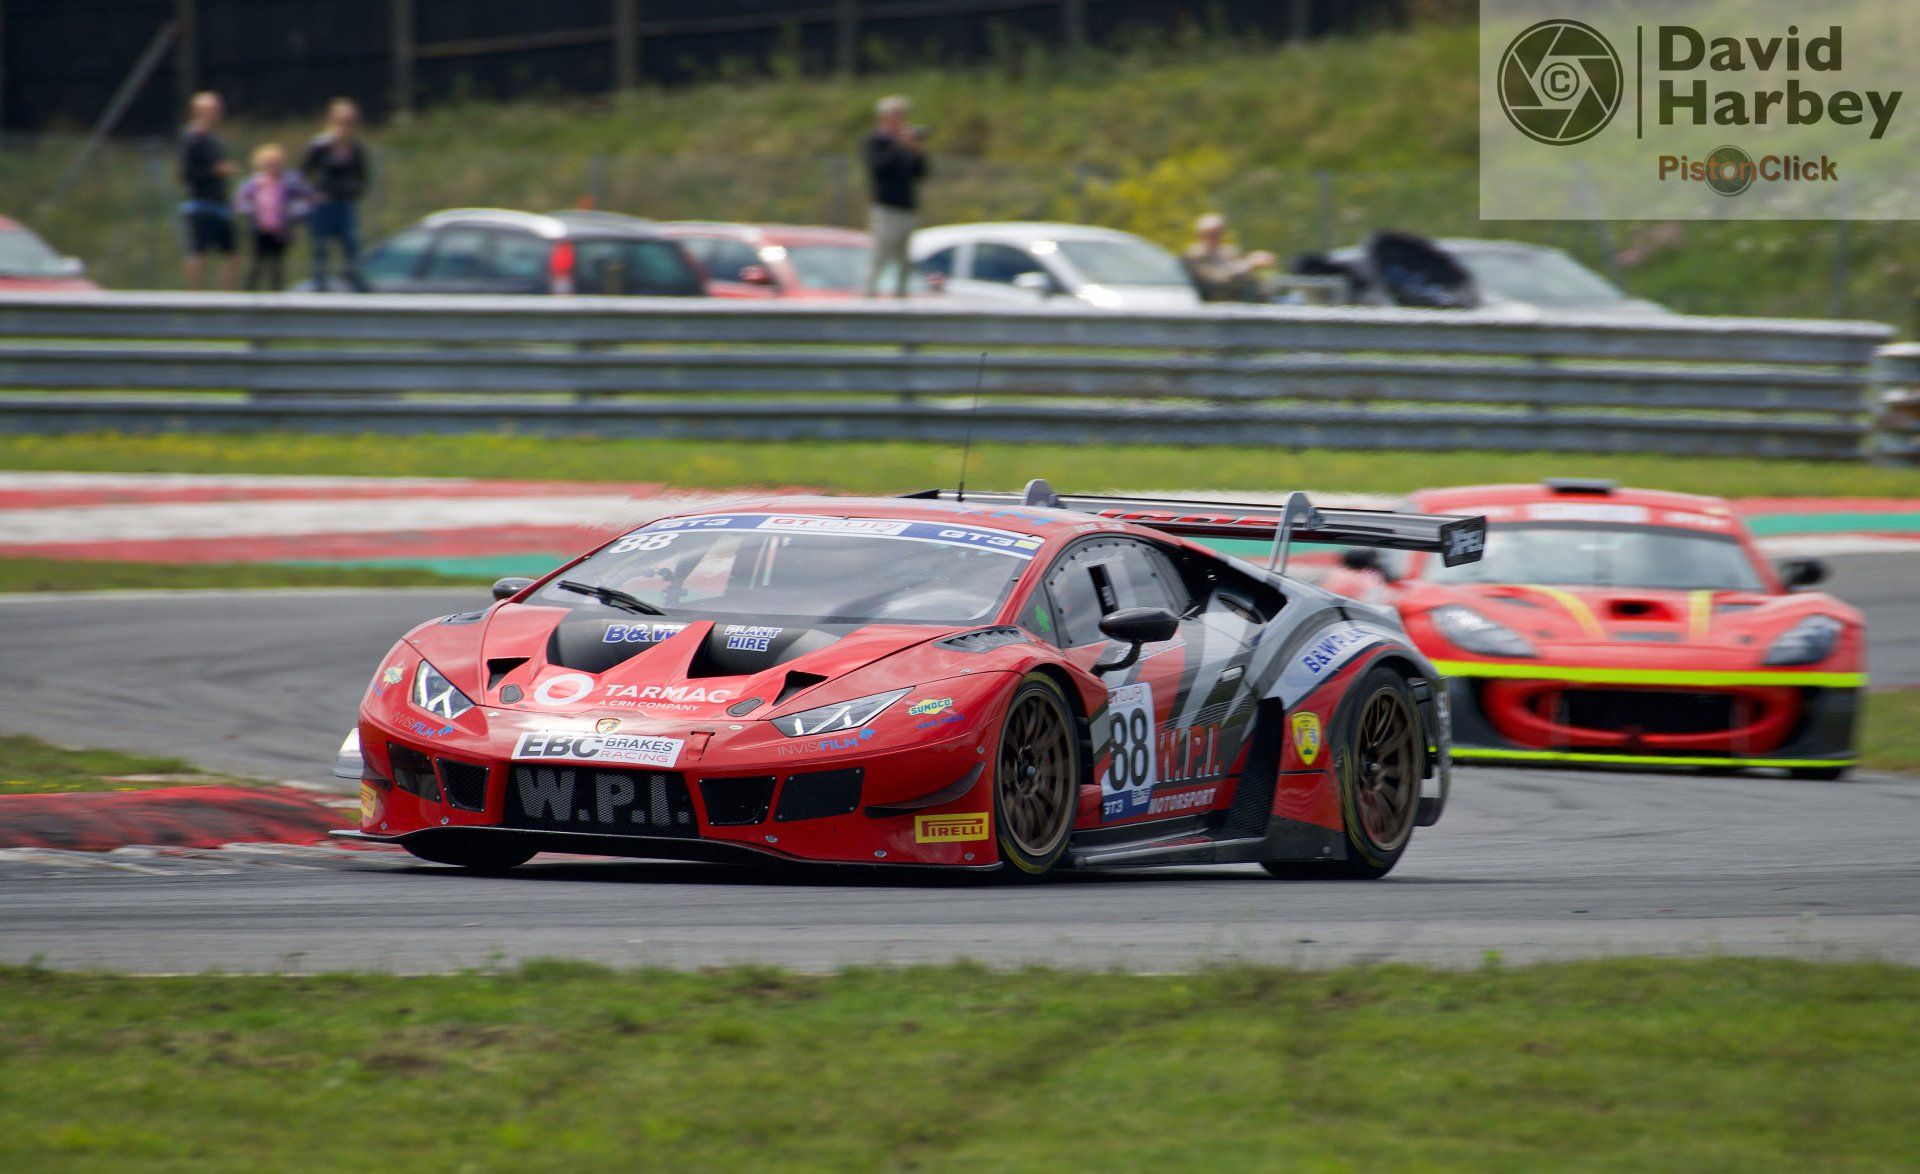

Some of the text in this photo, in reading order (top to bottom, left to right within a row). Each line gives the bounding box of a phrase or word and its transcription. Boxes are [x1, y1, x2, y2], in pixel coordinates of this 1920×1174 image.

[657, 518, 732, 529] GT3
[773, 518, 812, 526] GT
[609, 533, 679, 553] 88
[938, 530, 1015, 546] GT3
[602, 624, 686, 643] B&W
[724, 625, 783, 639] PLANT
[727, 636, 770, 652] HIRE
[605, 684, 733, 703] TARMAC
[637, 701, 701, 712] COMPANY
[911, 698, 952, 715] SUNOCO
[519, 734, 675, 758] EBC BRAKES
[1109, 708, 1149, 791] 88
[600, 751, 670, 763] RACING
[515, 767, 690, 827] W.P.I.
[1147, 788, 1217, 814] MOTORSPORT
[922, 818, 984, 837] PIRELLI
